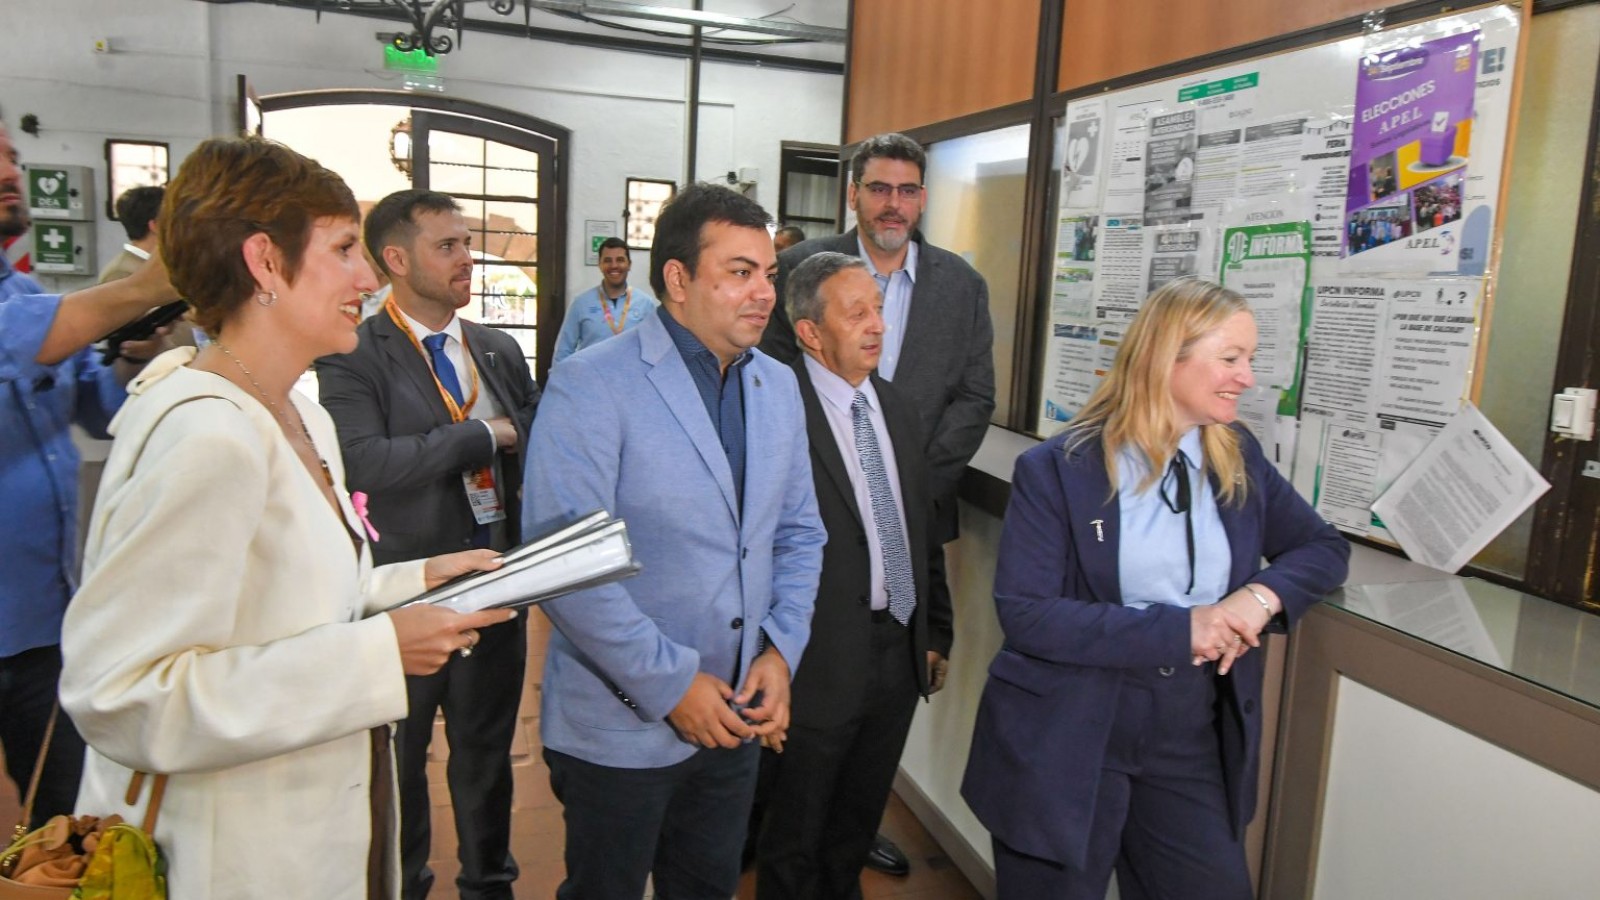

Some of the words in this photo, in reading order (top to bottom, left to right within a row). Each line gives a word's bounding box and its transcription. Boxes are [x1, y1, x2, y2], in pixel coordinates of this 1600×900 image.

[1361, 79, 1436, 123] ELECCIONES
[38, 198, 60, 206] DEA
[1317, 286, 1341, 295] UPCN
[1343, 286, 1385, 297] INFORMA
